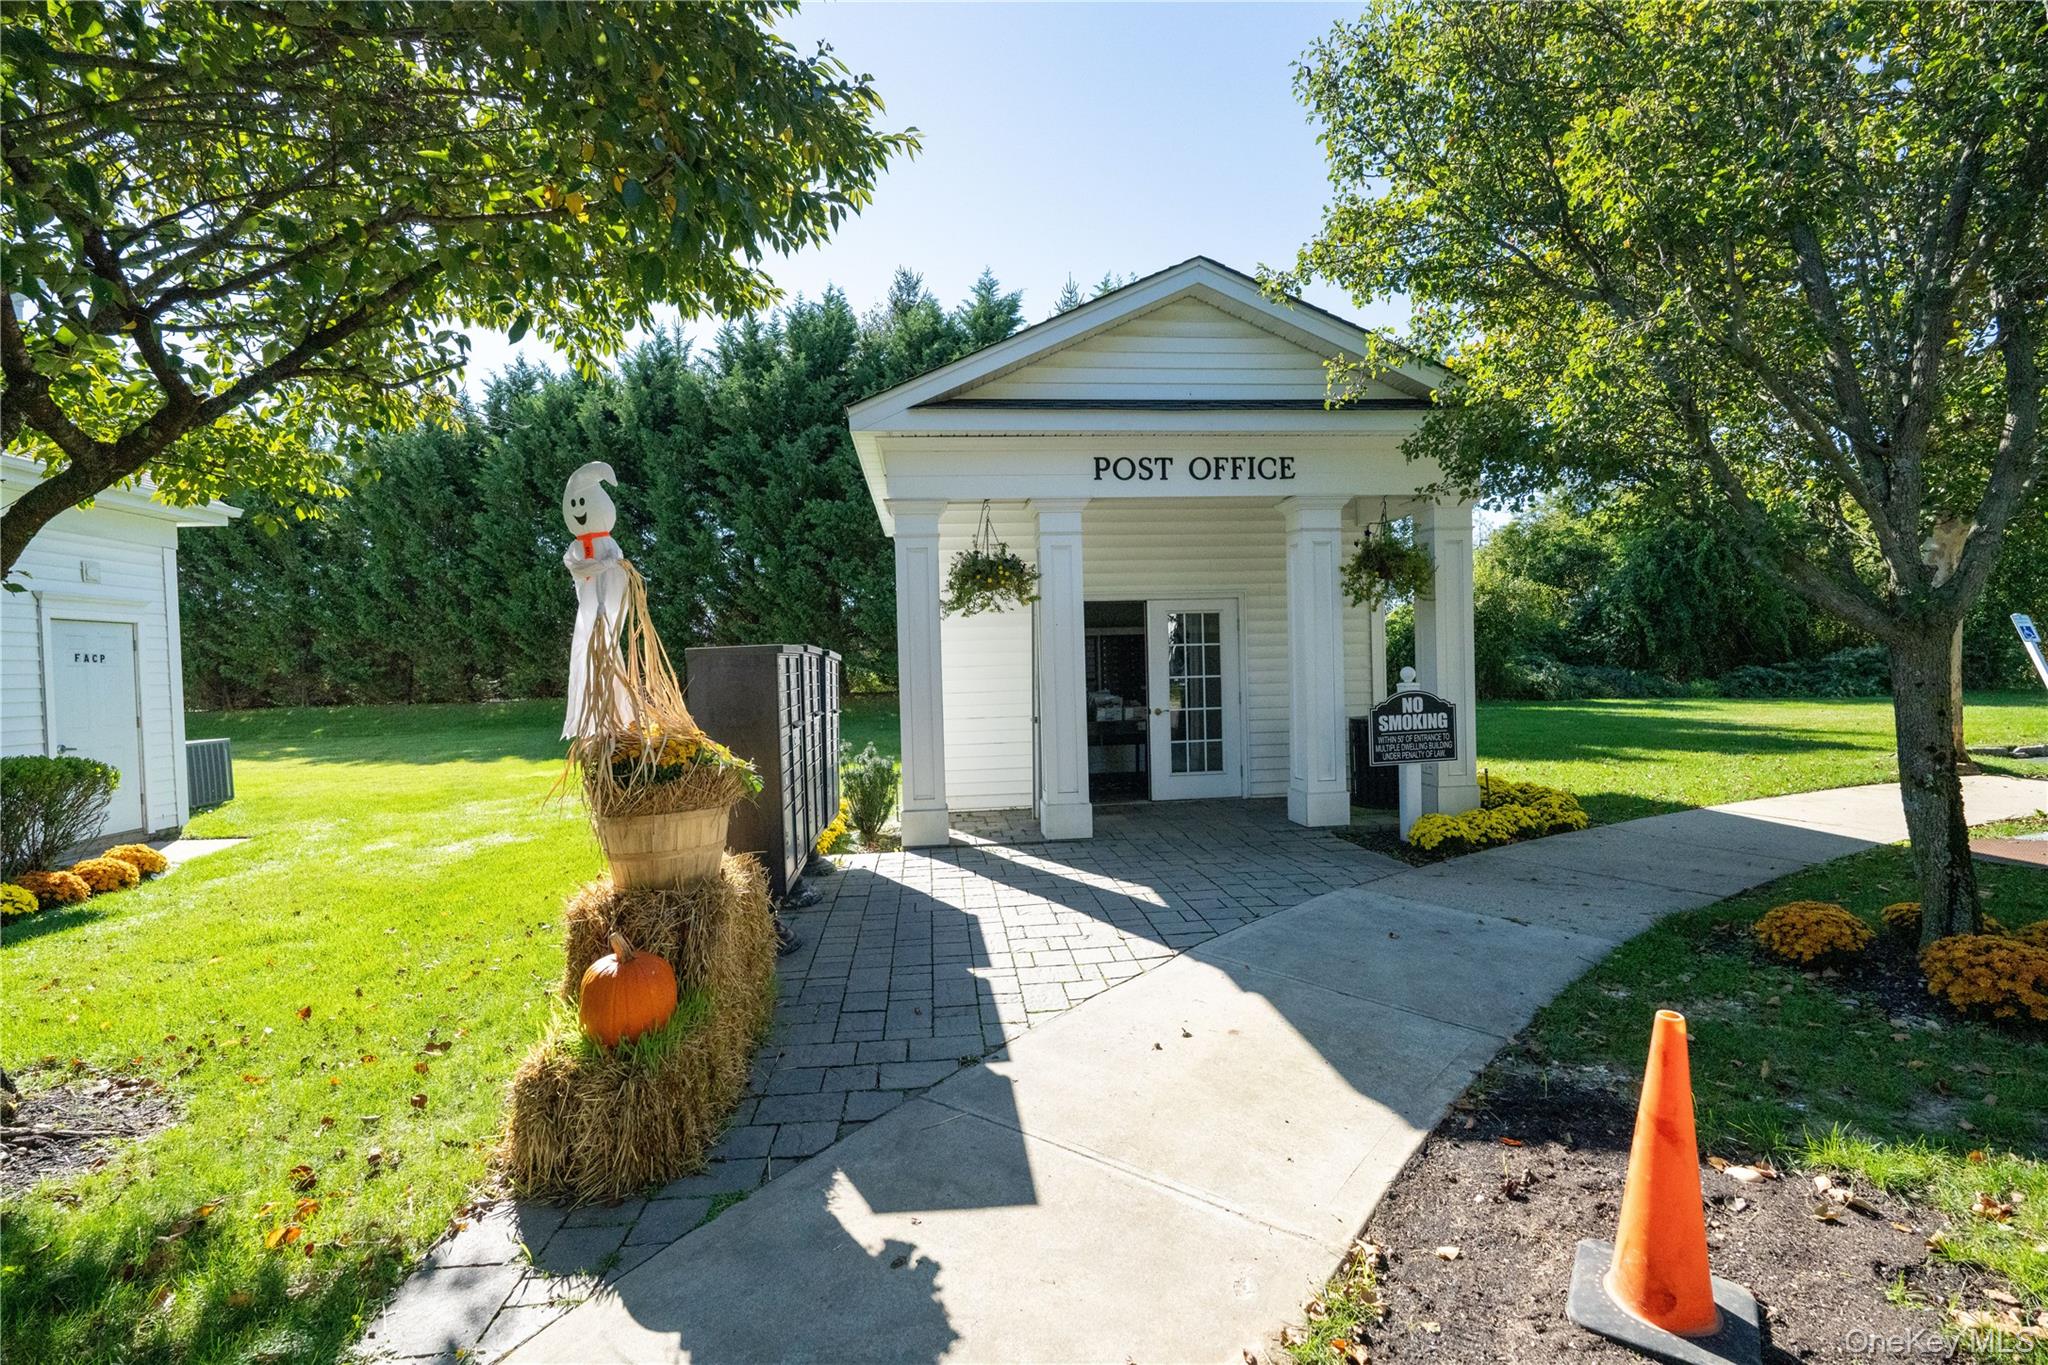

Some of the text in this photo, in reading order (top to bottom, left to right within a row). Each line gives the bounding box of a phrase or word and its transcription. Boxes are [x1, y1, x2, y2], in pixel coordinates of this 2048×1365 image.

[1093, 456, 1296, 481] POST OFFICE
[74, 653, 106, 663] FACP
[1401, 696, 1424, 713] NO
[1378, 712, 1448, 731] SMOKING
[1377, 735, 1396, 744] WITHIN
[1405, 734, 1413, 743] OF
[1413, 733, 1442, 742] ENTRANCE
[1442, 732, 1450, 741] TO
[1375, 740, 1453, 752] MULTIPLE DWELLING BUILDING
[1382, 752, 1401, 760] UNDER
[1401, 750, 1425, 760] PENALTY
[1425, 750, 1433, 758] OF
